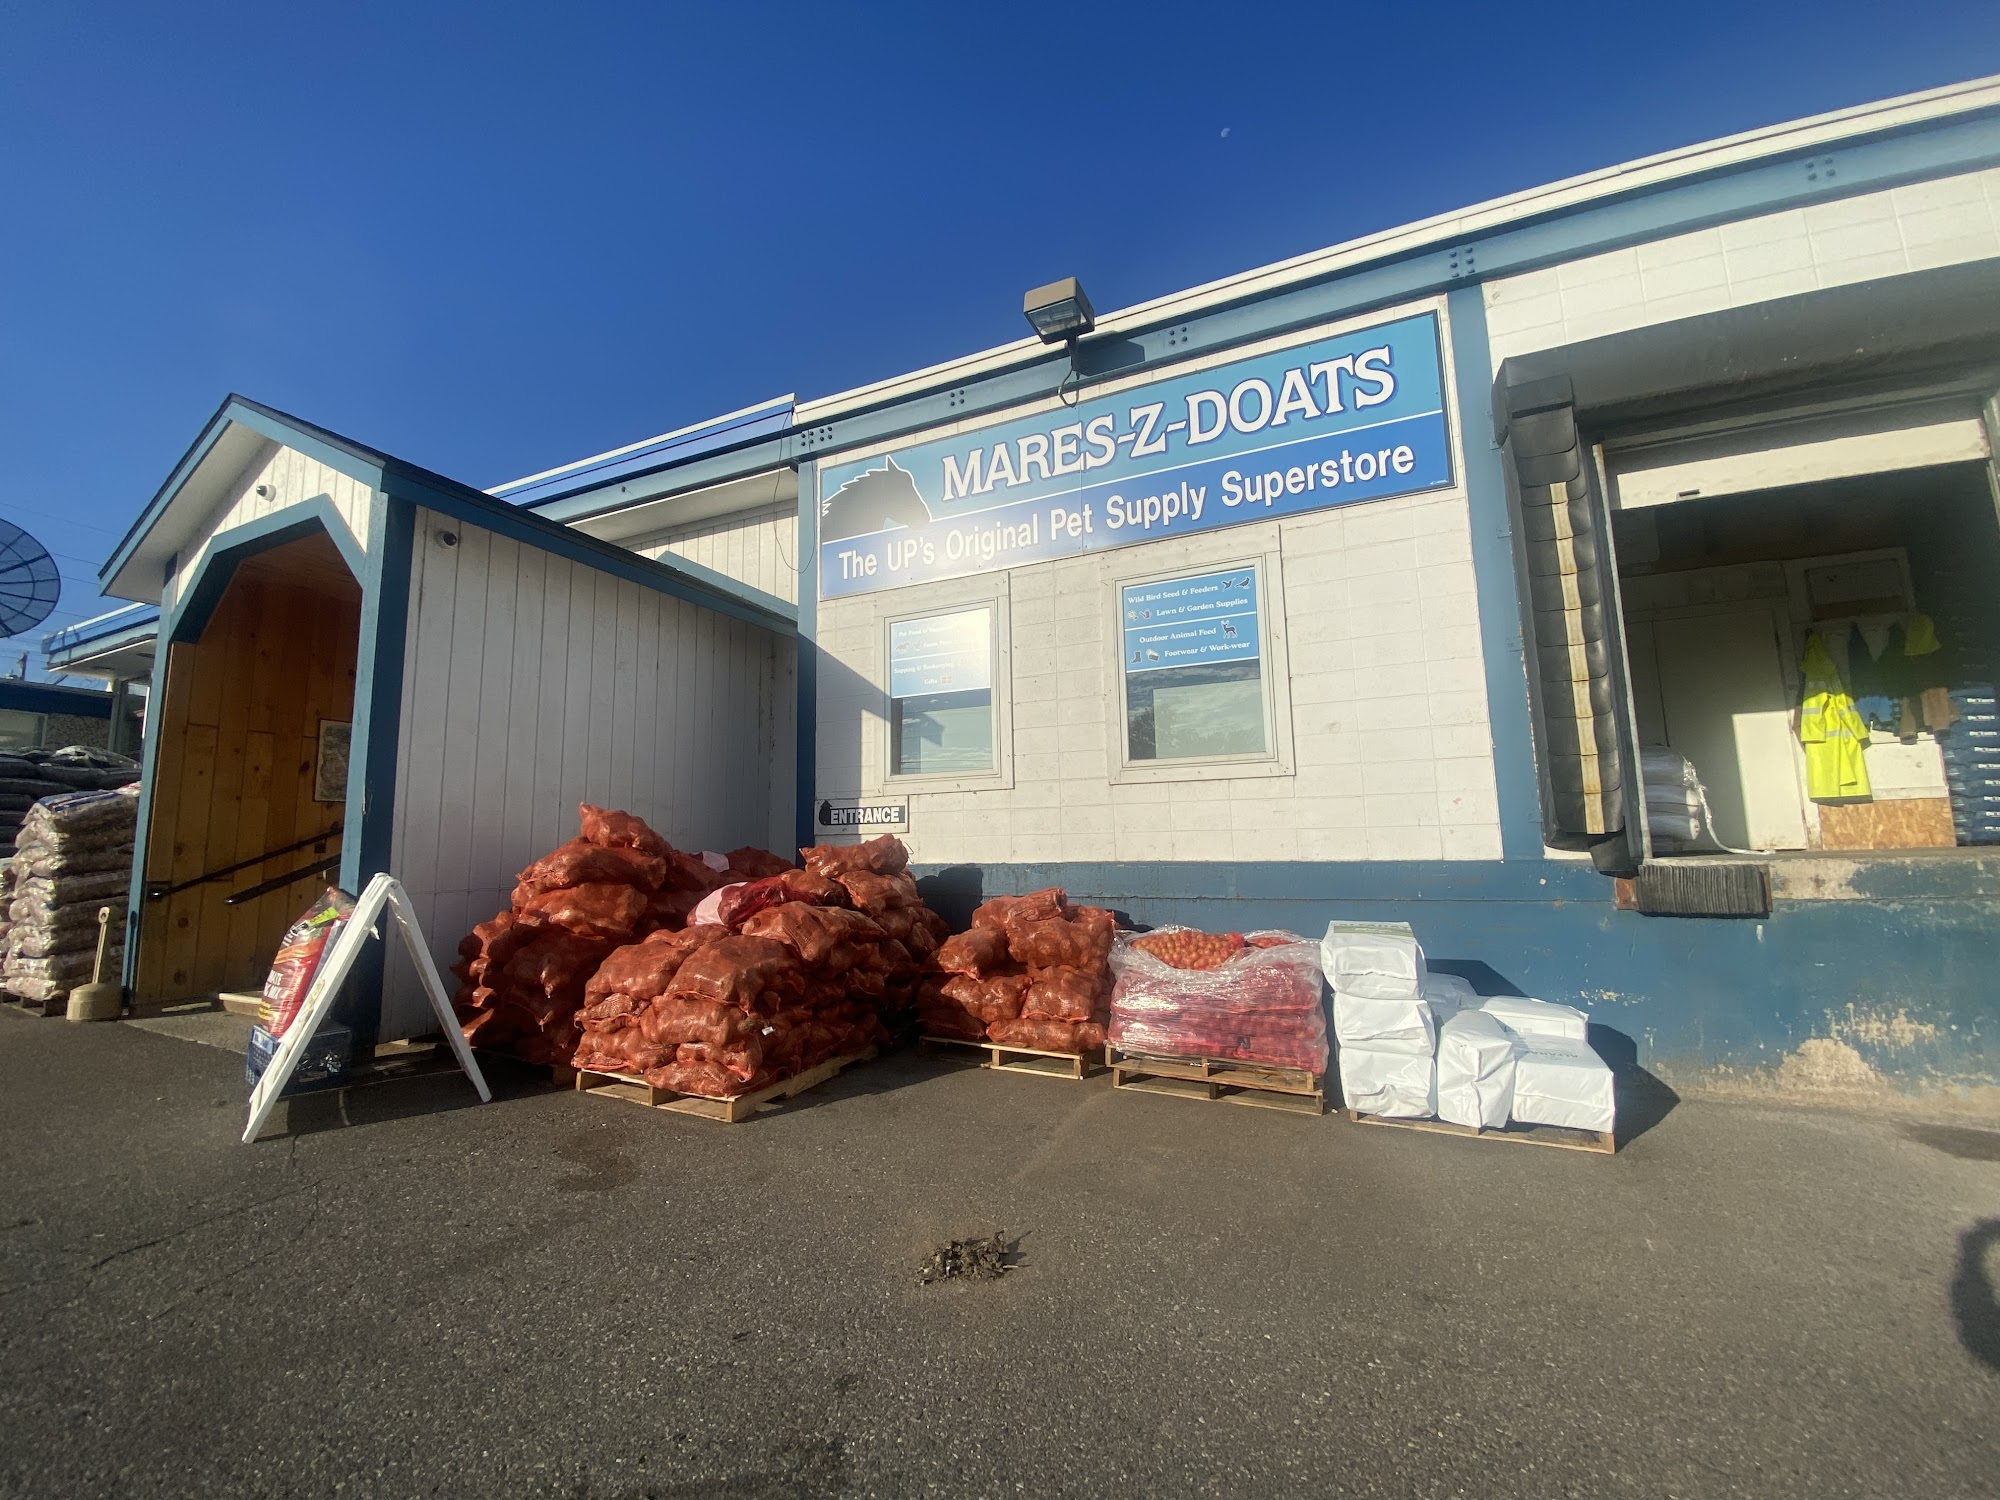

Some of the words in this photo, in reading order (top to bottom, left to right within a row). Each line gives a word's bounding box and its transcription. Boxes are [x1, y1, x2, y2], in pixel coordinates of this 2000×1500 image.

[941, 344, 1397, 502] MARES-Z-DOATS
[838, 550, 878, 580] The
[886, 537, 935, 572] UP's
[945, 513, 1039, 562] Original
[1050, 503, 1094, 541] Pet
[1105, 481, 1207, 529] Supply
[1221, 444, 1416, 507] Superstore
[1128, 596, 1145, 604] Wild
[1145, 593, 1161, 602] Bird
[1162, 590, 1180, 599] Seed
[1190, 585, 1219, 595] Feeders
[1156, 608, 1177, 617] Lawn
[1186, 603, 1215, 612] Garden
[1215, 597, 1248, 609] Supplies
[1139, 634, 1168, 644] Outdoor
[1170, 631, 1197, 640] Animal
[1199, 627, 1217, 636] Feed
[1164, 647, 1198, 657] Footwear
[1200, 645, 1208, 653] &
[1208, 642, 1250, 652] Work-wear
[830, 806, 900, 825] ENTRANCE
